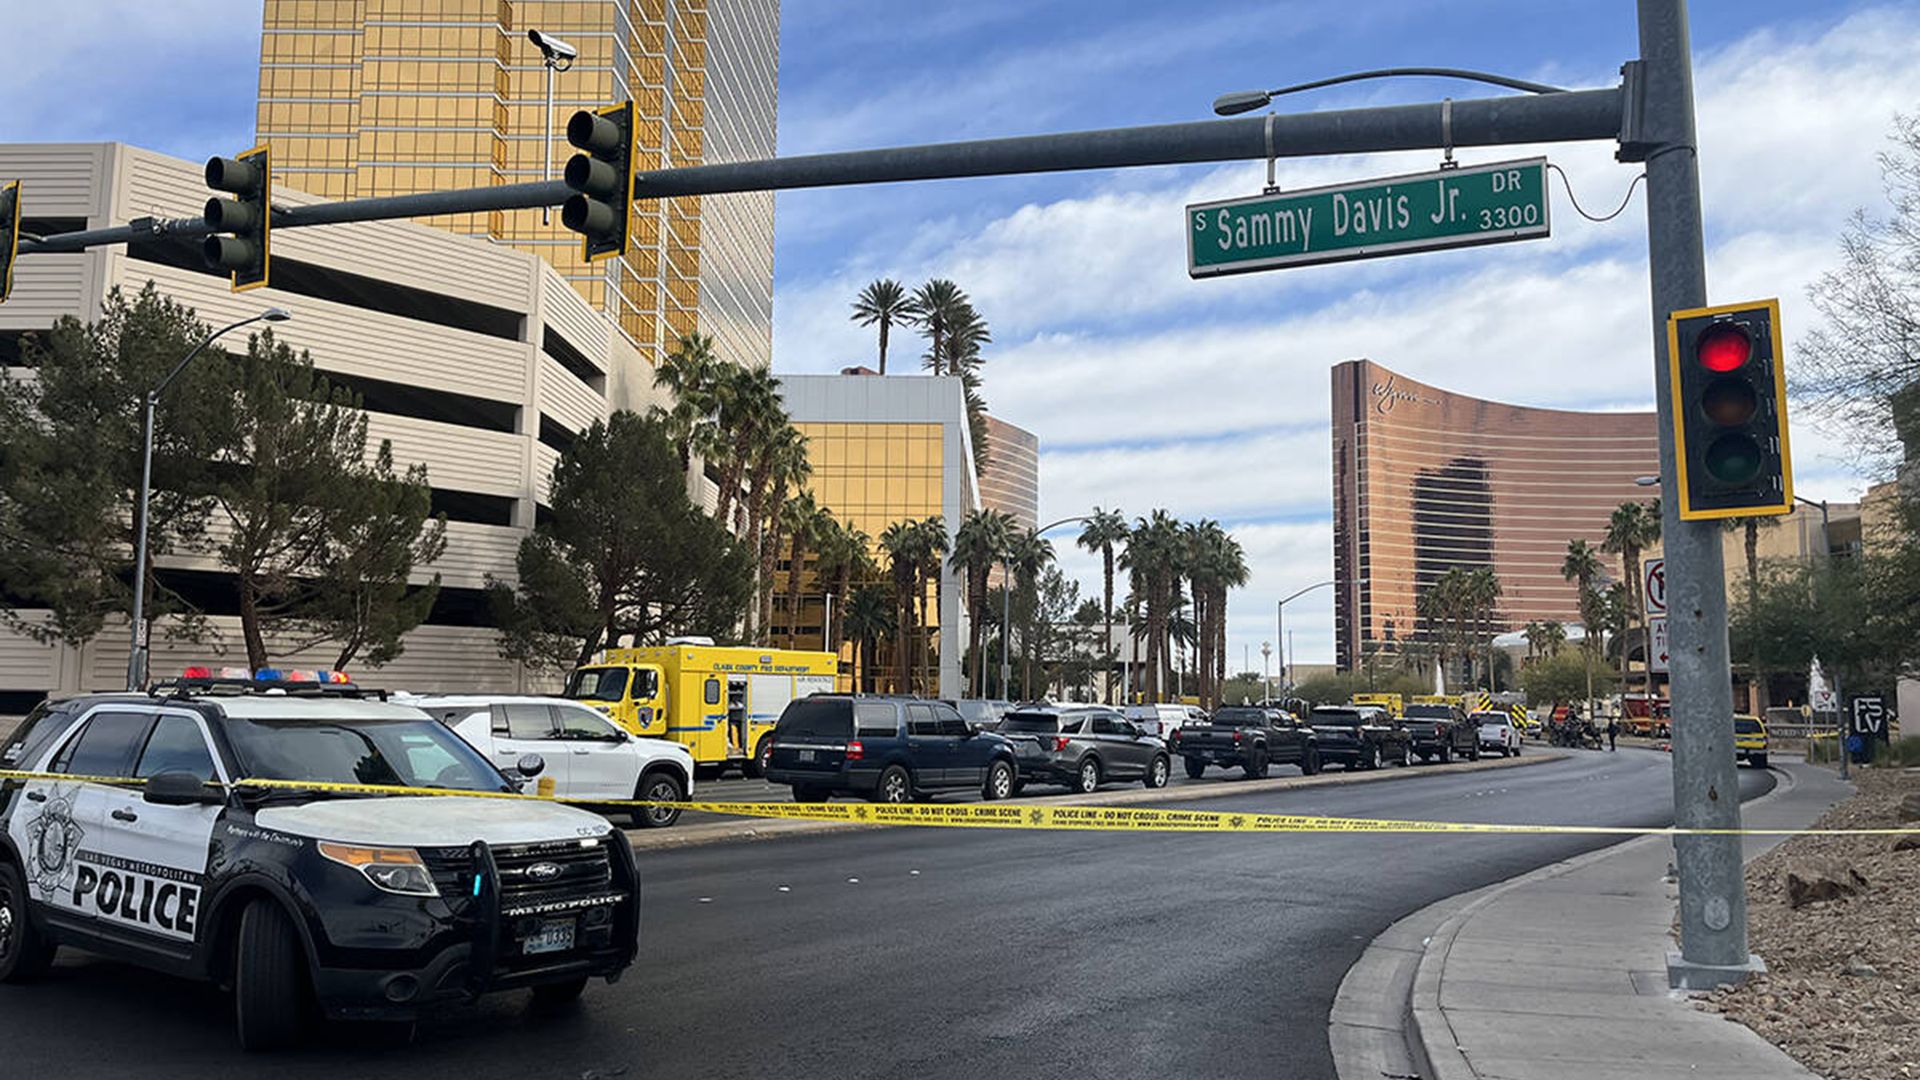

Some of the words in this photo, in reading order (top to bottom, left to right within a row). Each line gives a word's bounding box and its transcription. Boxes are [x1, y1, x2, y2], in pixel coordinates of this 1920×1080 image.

[1196, 212, 1207, 231] S
[1218, 208, 1312, 251] Sammy
[1333, 186, 1410, 236] Davis
[1431, 180, 1467, 224] Jr.
[1492, 170, 1522, 193] DR
[1480, 203, 1538, 230] 3300
[875, 806, 898, 814] POLICE
[900, 806, 914, 815] LINE
[931, 807, 945, 816] NOT
[945, 807, 968, 816] CROSS
[974, 808, 998, 817] CRIME
[999, 808, 1022, 817] SCENE
[1053, 810, 1079, 819] POLICE
[1081, 810, 1097, 819] LINE
[1104, 811, 1115, 819] DO
[1117, 811, 1132, 820] NOT
[1133, 812, 1159, 820] CROSS
[1166, 813, 1192, 821] CRIME
[1194, 814, 1220, 822] SCENE
[85, 853, 99, 863] LAS
[101, 858, 128, 869] VEGAS
[129, 863, 197, 883] METROPOLITAN
[73, 864, 199, 934] POLICE
